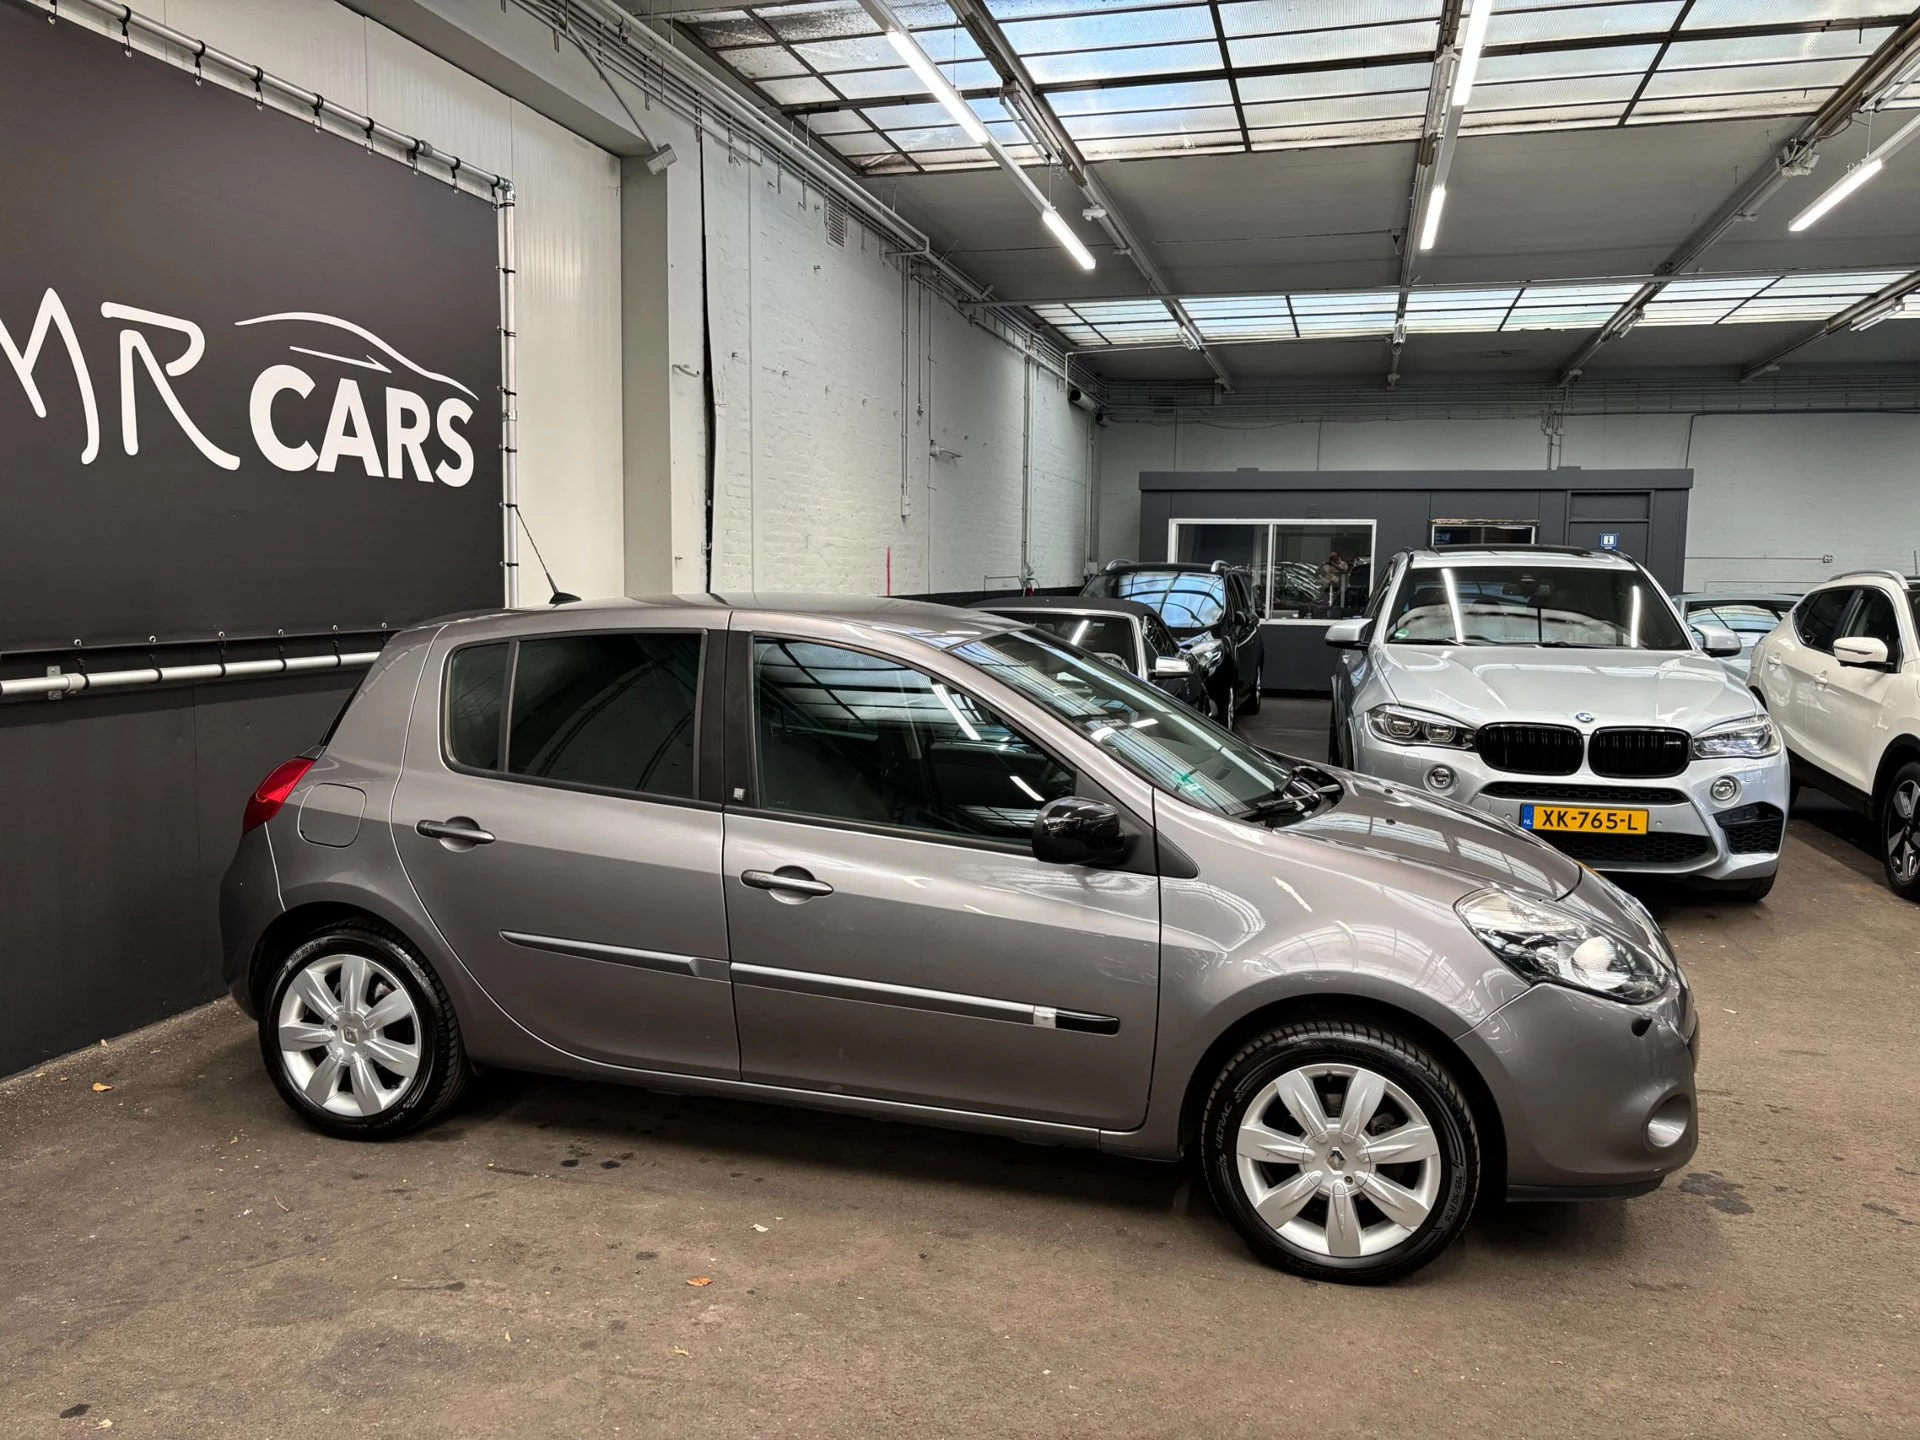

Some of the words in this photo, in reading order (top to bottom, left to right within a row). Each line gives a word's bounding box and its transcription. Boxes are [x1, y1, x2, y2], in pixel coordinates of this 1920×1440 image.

[249, 364, 475, 488] CARS
[1542, 809, 1639, 831] XK-765-L
[1215, 1101, 1233, 1149] ULTRAC
